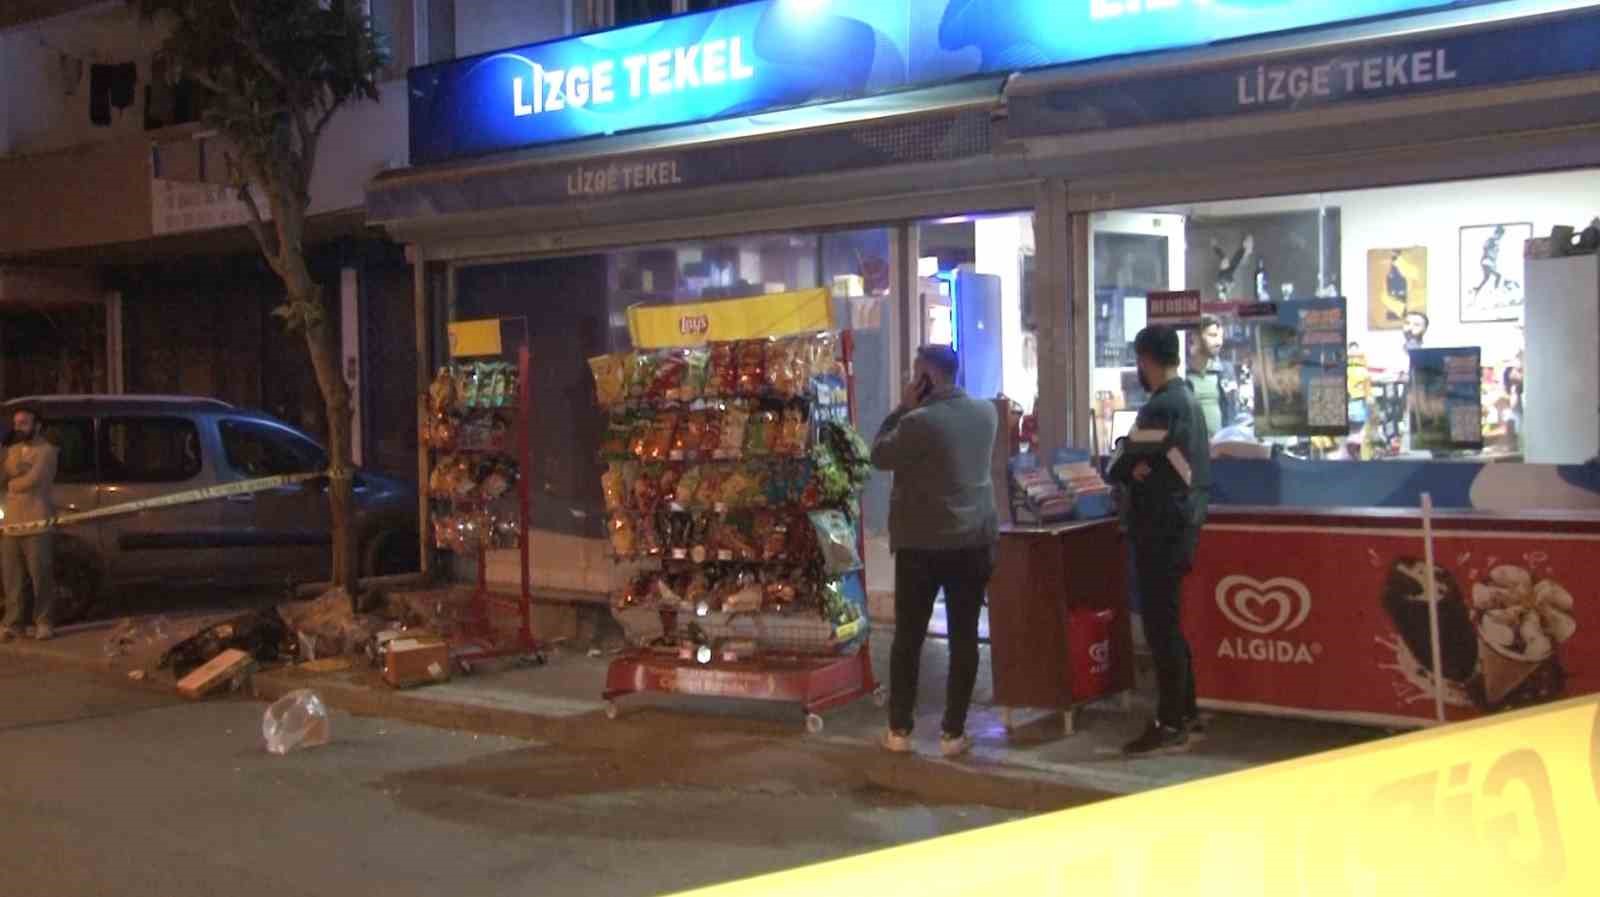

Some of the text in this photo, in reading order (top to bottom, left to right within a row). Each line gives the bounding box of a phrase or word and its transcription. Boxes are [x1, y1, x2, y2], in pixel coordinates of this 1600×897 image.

[513, 37, 753, 116] LİZGE TEKEL
[1237, 48, 1457, 104] LİZGE TEKEL
[567, 160, 682, 196] LİZGE TEKEL
